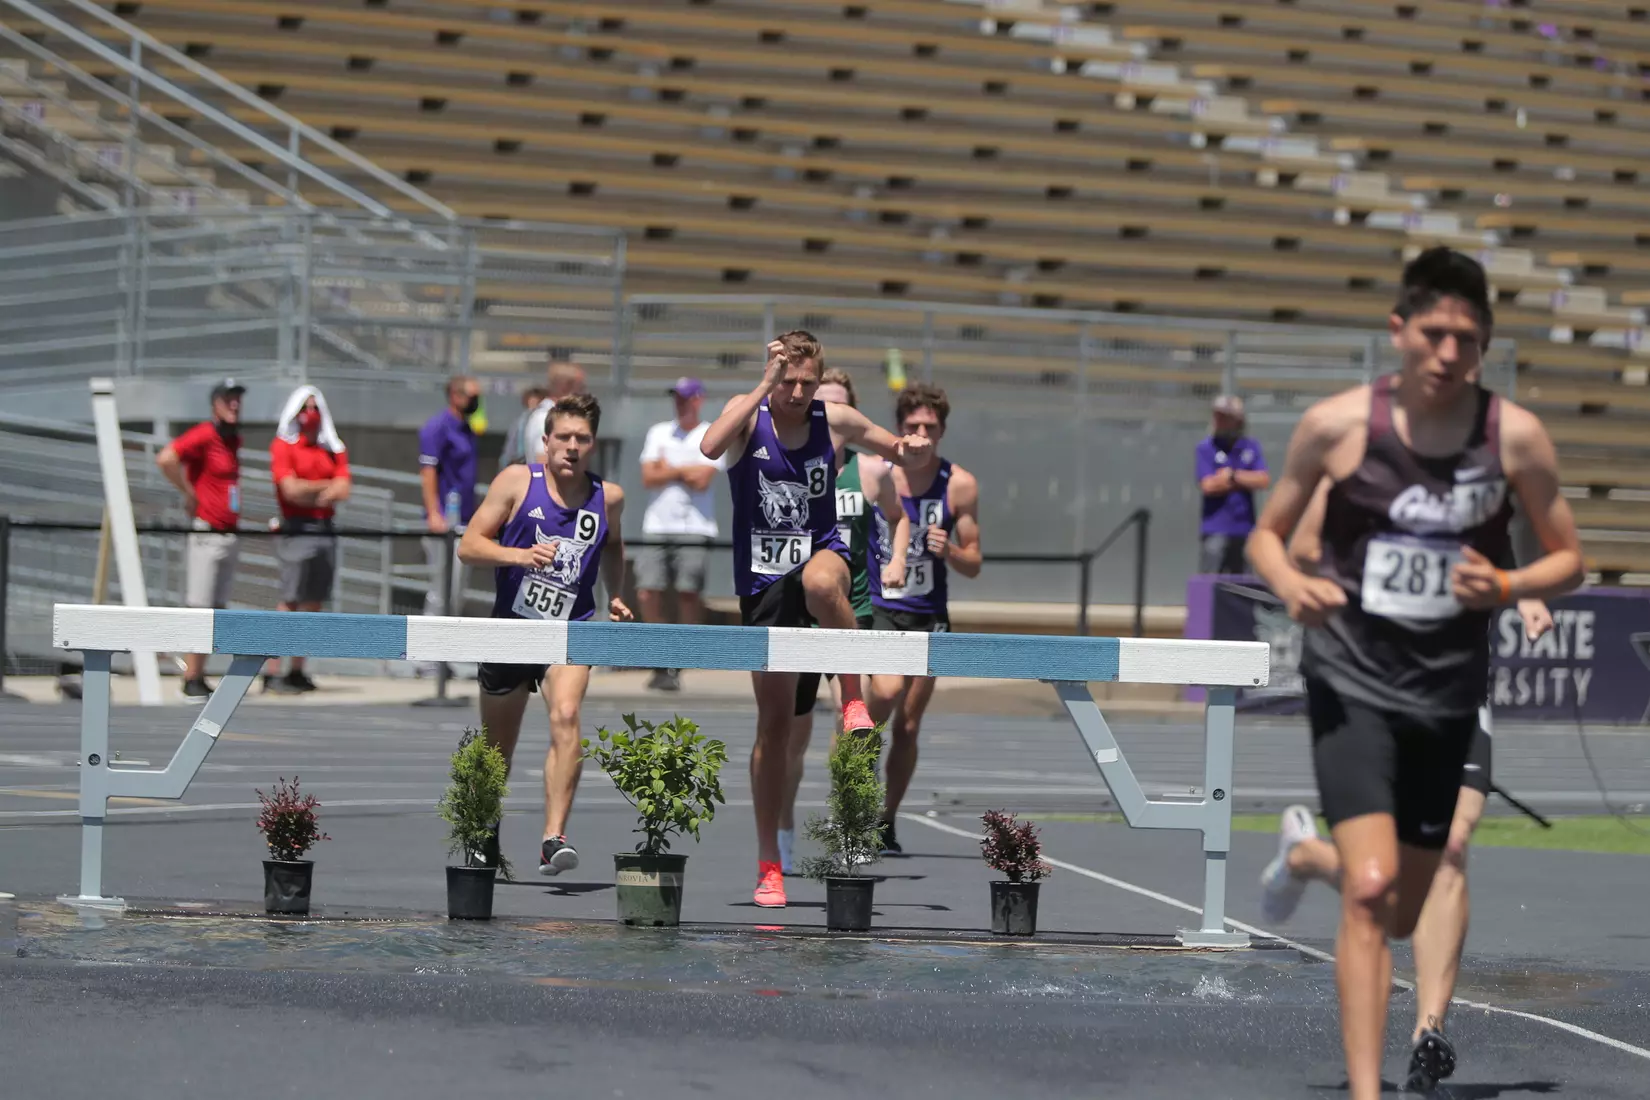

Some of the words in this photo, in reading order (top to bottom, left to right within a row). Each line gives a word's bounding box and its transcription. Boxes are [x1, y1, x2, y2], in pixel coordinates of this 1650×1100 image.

[809, 467, 825, 496] 8
[839, 494, 857, 514] 11
[925, 502, 938, 525] 6
[578, 513, 597, 542] 9
[760, 537, 802, 565] 576
[1382, 550, 1449, 597] 281
[524, 582, 568, 618] 555
[1497, 607, 1596, 661] STATE
[1492, 665, 1593, 708] RSITY
